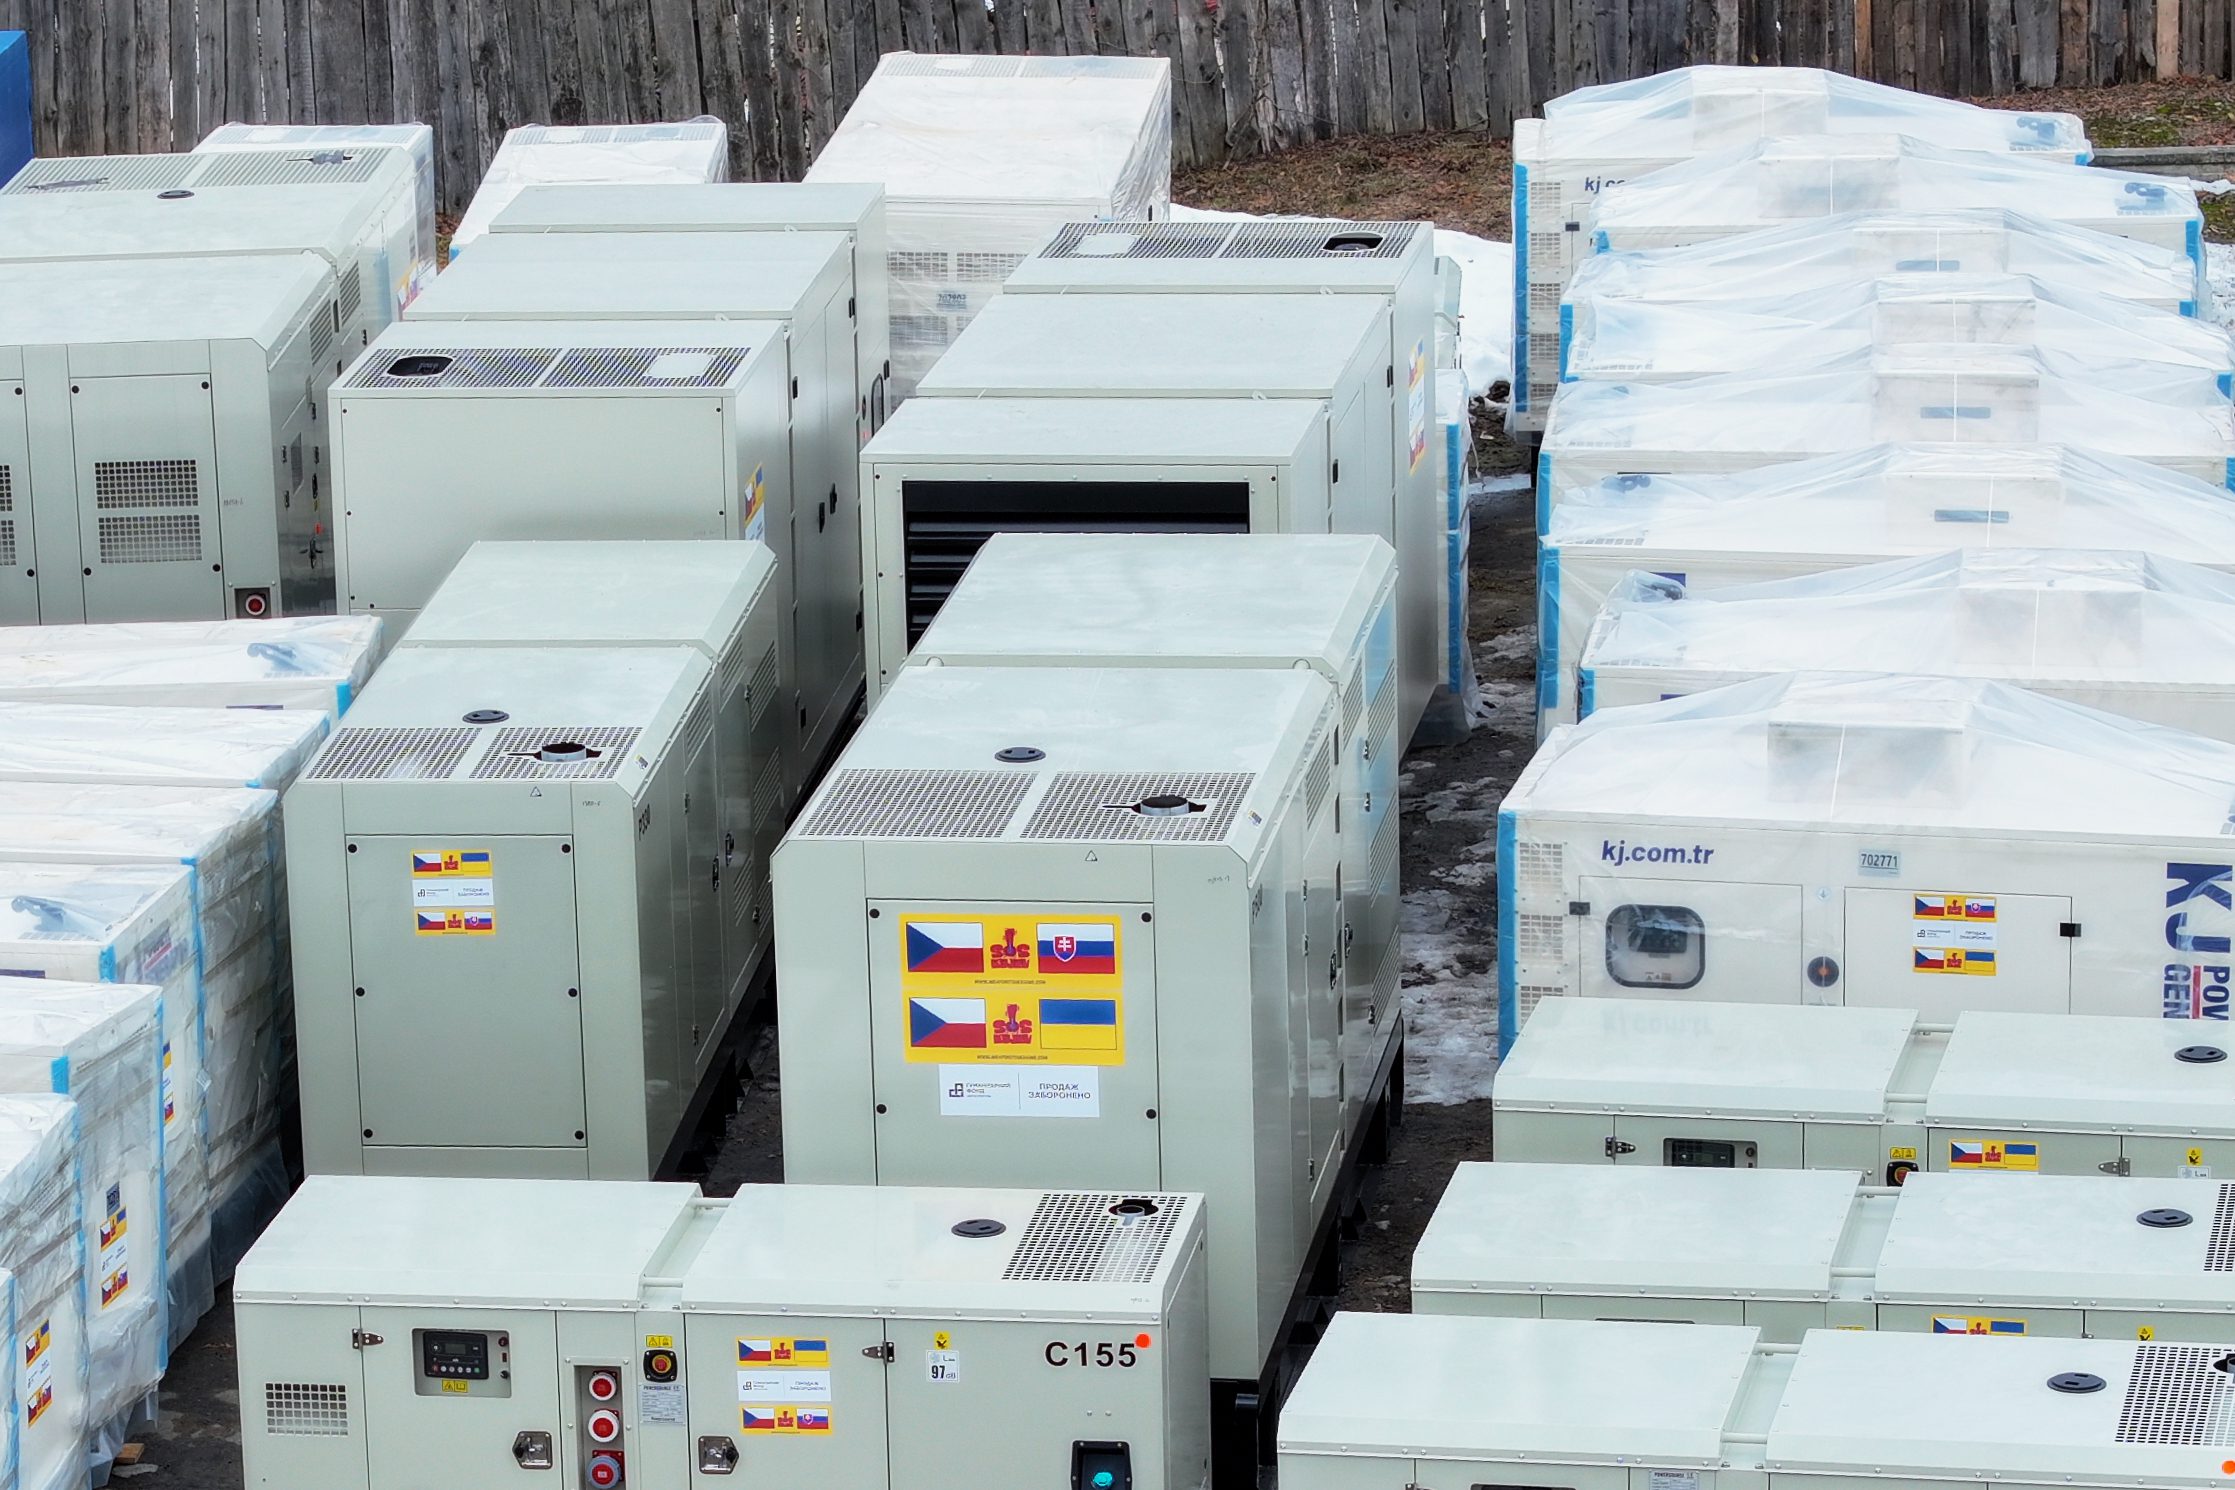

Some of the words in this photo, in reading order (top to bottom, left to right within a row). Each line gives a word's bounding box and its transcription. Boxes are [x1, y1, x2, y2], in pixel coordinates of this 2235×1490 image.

[1601, 840, 1714, 866] kj.com.tr
[1861, 853, 1898, 868] 702771
[2165, 862, 2233, 953] KJ
[1039, 1082, 1079, 1091] ПРОДАЖ
[1028, 1091, 1091, 1099] ЗАБОРОНЕНО
[1045, 1342, 1136, 1367] C155
[931, 1365, 945, 1379] 97
